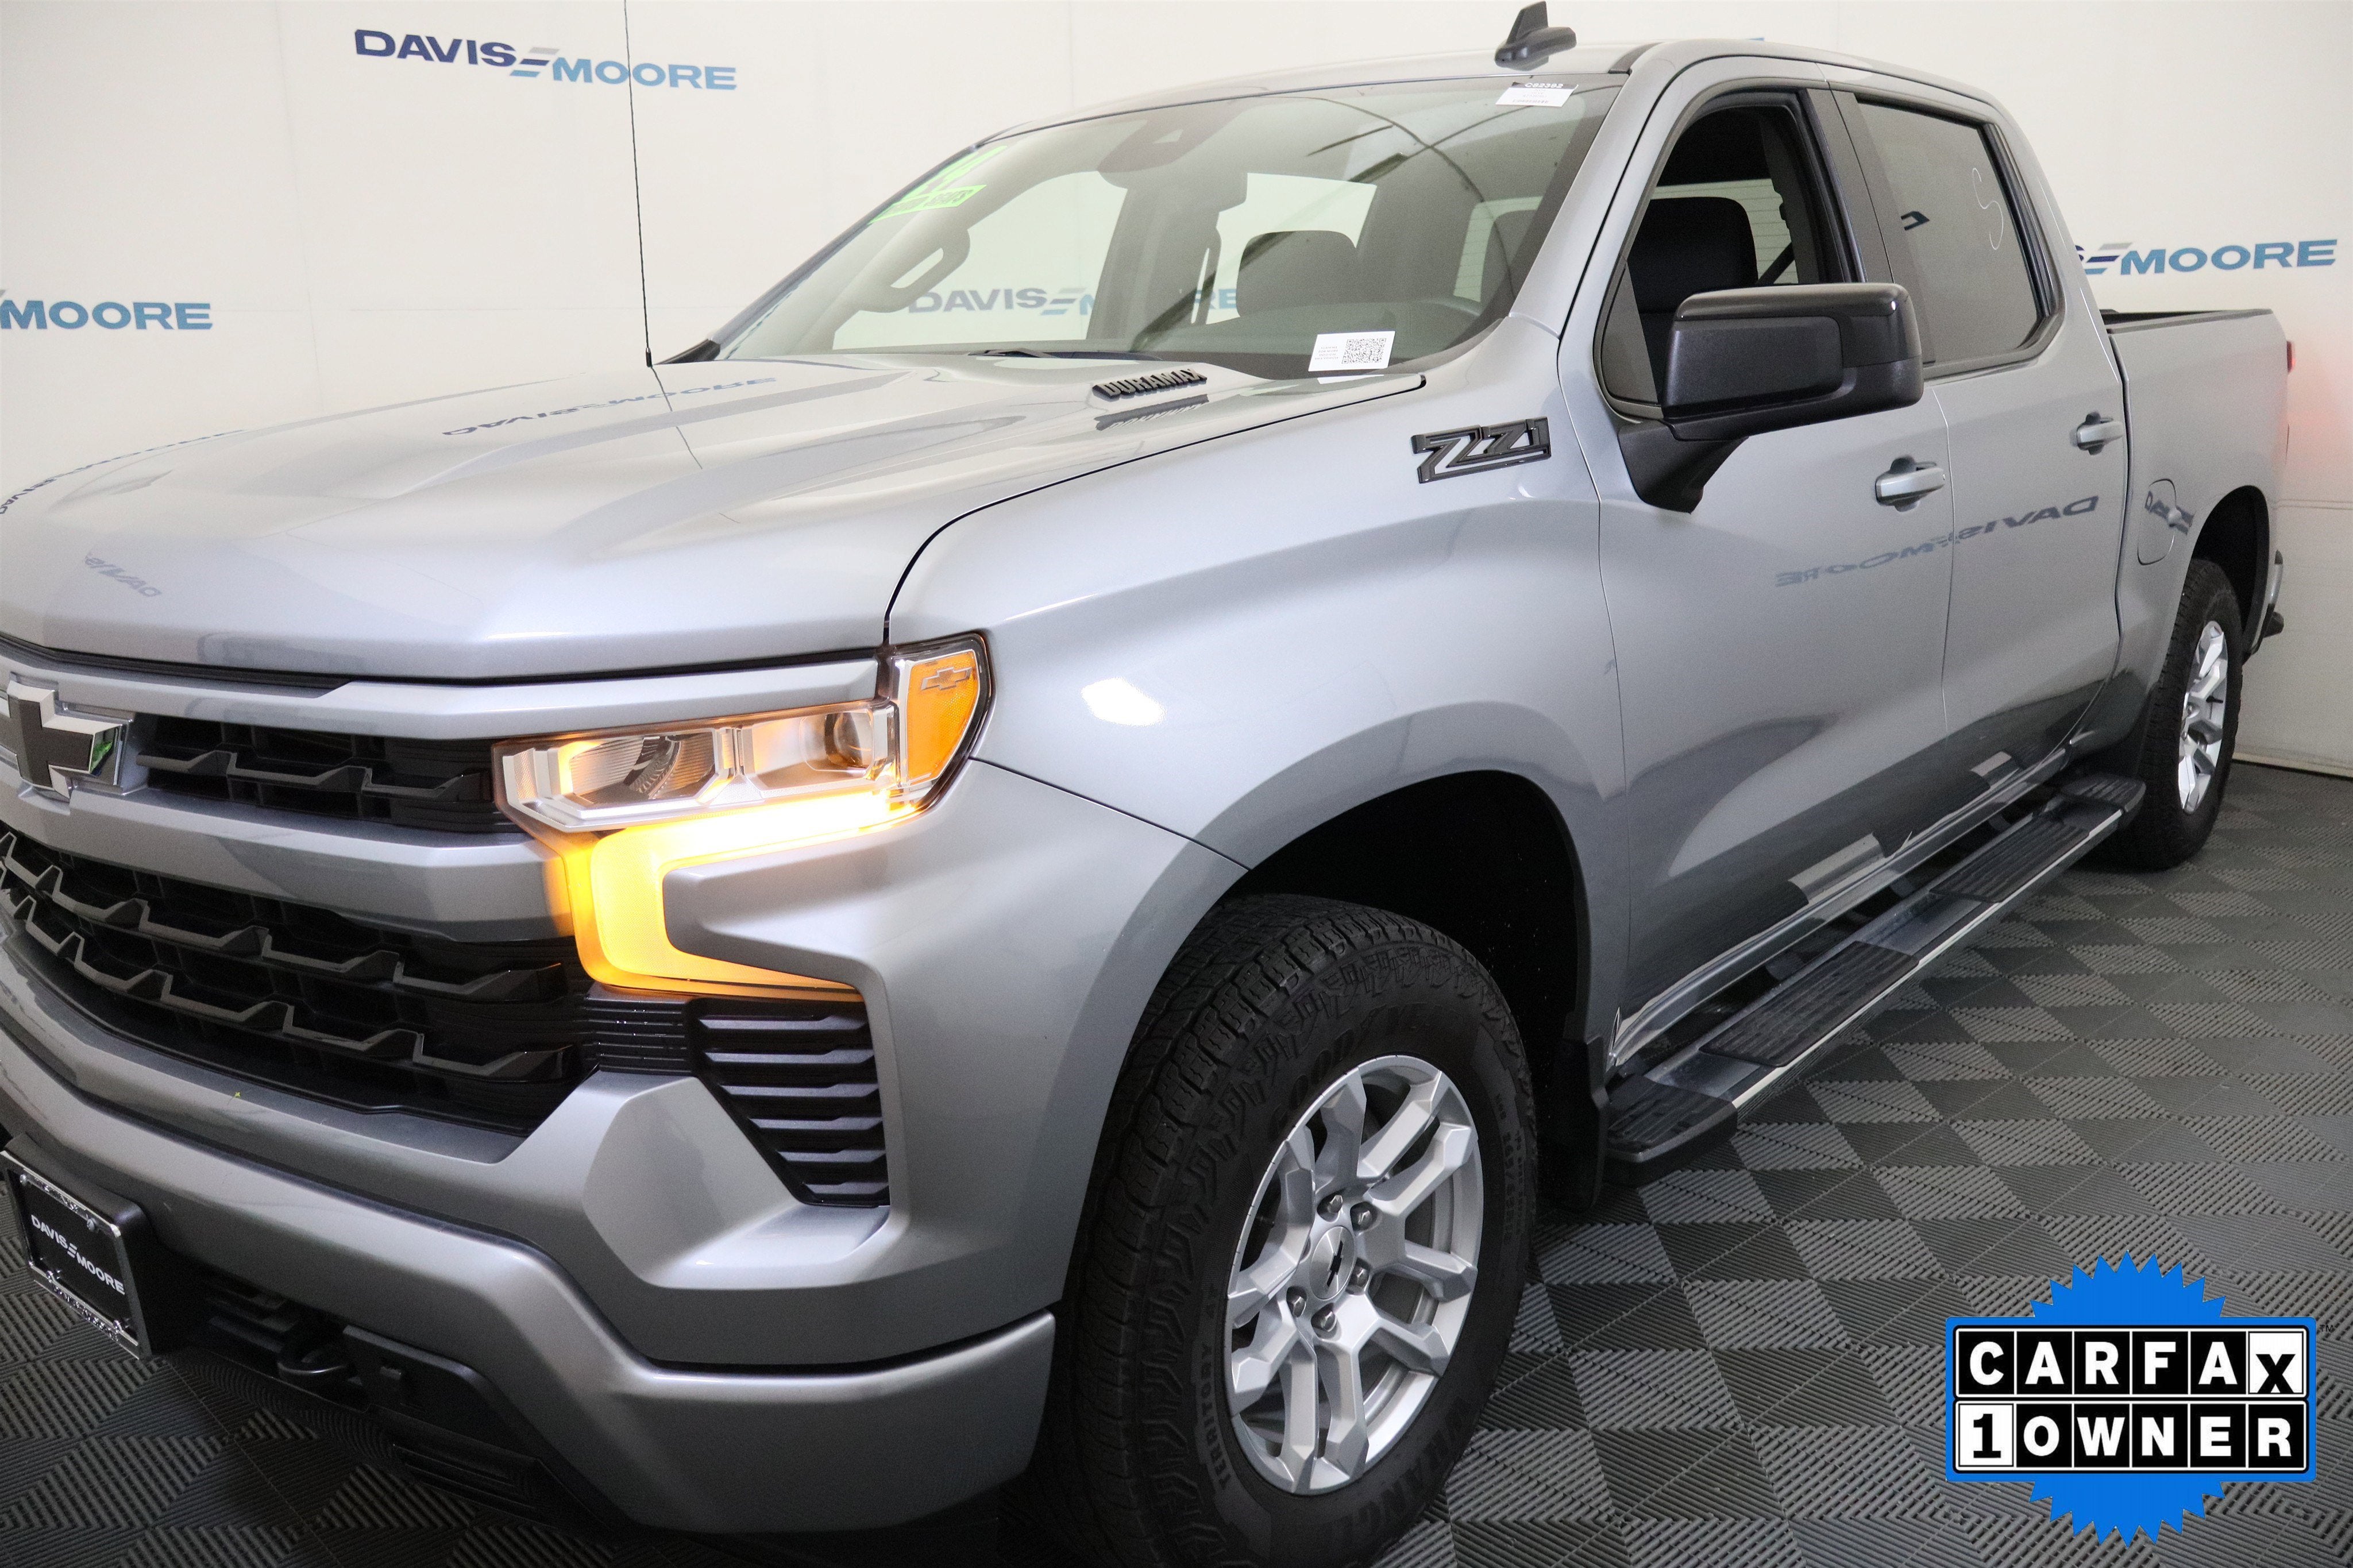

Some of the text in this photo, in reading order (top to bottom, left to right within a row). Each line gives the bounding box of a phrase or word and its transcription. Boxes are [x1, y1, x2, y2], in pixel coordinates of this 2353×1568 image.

[355, 29, 737, 90] DAVIS MOORE
[2120, 239, 2337, 275] MOORE
[0, 300, 213, 330] MOORE
[908, 288, 1047, 314] DAVIS
[1092, 368, 1208, 399] DURAMAX
[1411, 416, 1552, 484] Z71
[31, 1214, 125, 1295] DAVIS MOORE
[1201, 1342, 1232, 1491] TERRITORY
